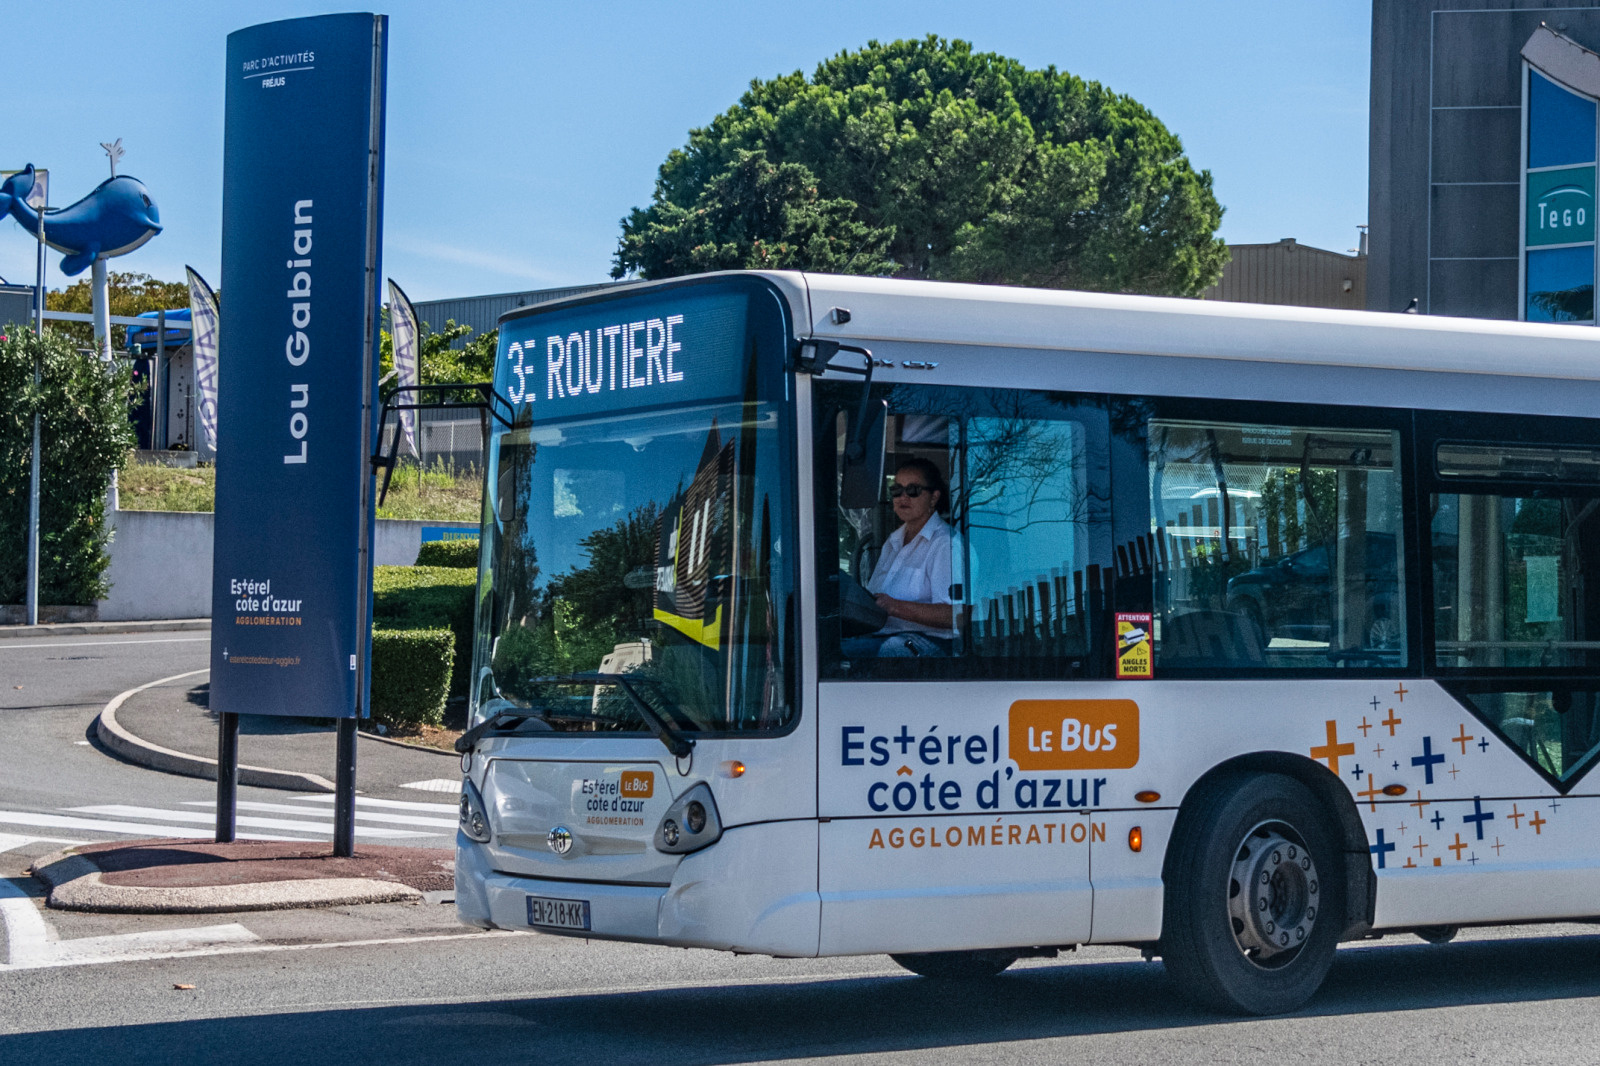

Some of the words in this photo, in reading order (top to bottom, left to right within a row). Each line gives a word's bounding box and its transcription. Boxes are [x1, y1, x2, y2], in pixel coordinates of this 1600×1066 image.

[243, 59, 260, 71] PARC
[262, 50, 315, 68] D'ACTIVITÉS
[262, 76, 285, 88] FRÉJUS
[286, 199, 313, 366] Gabian
[547, 315, 684, 399] ROUTIERE
[284, 384, 308, 464] Lou
[231, 579, 270, 594] Estérel
[236, 594, 259, 611] côte
[262, 595, 302, 611] d'azur
[841, 725, 999, 766] Estérel
[582, 779, 620, 795] Estérel
[868, 765, 962, 812] côte
[976, 766, 1106, 810] d'azur
[587, 794, 609, 812] côte
[611, 796, 645, 813] d'azur
[868, 817, 1106, 850] AGGLOMÉRATION
[533, 900, 582, 926] EN-218-KK
